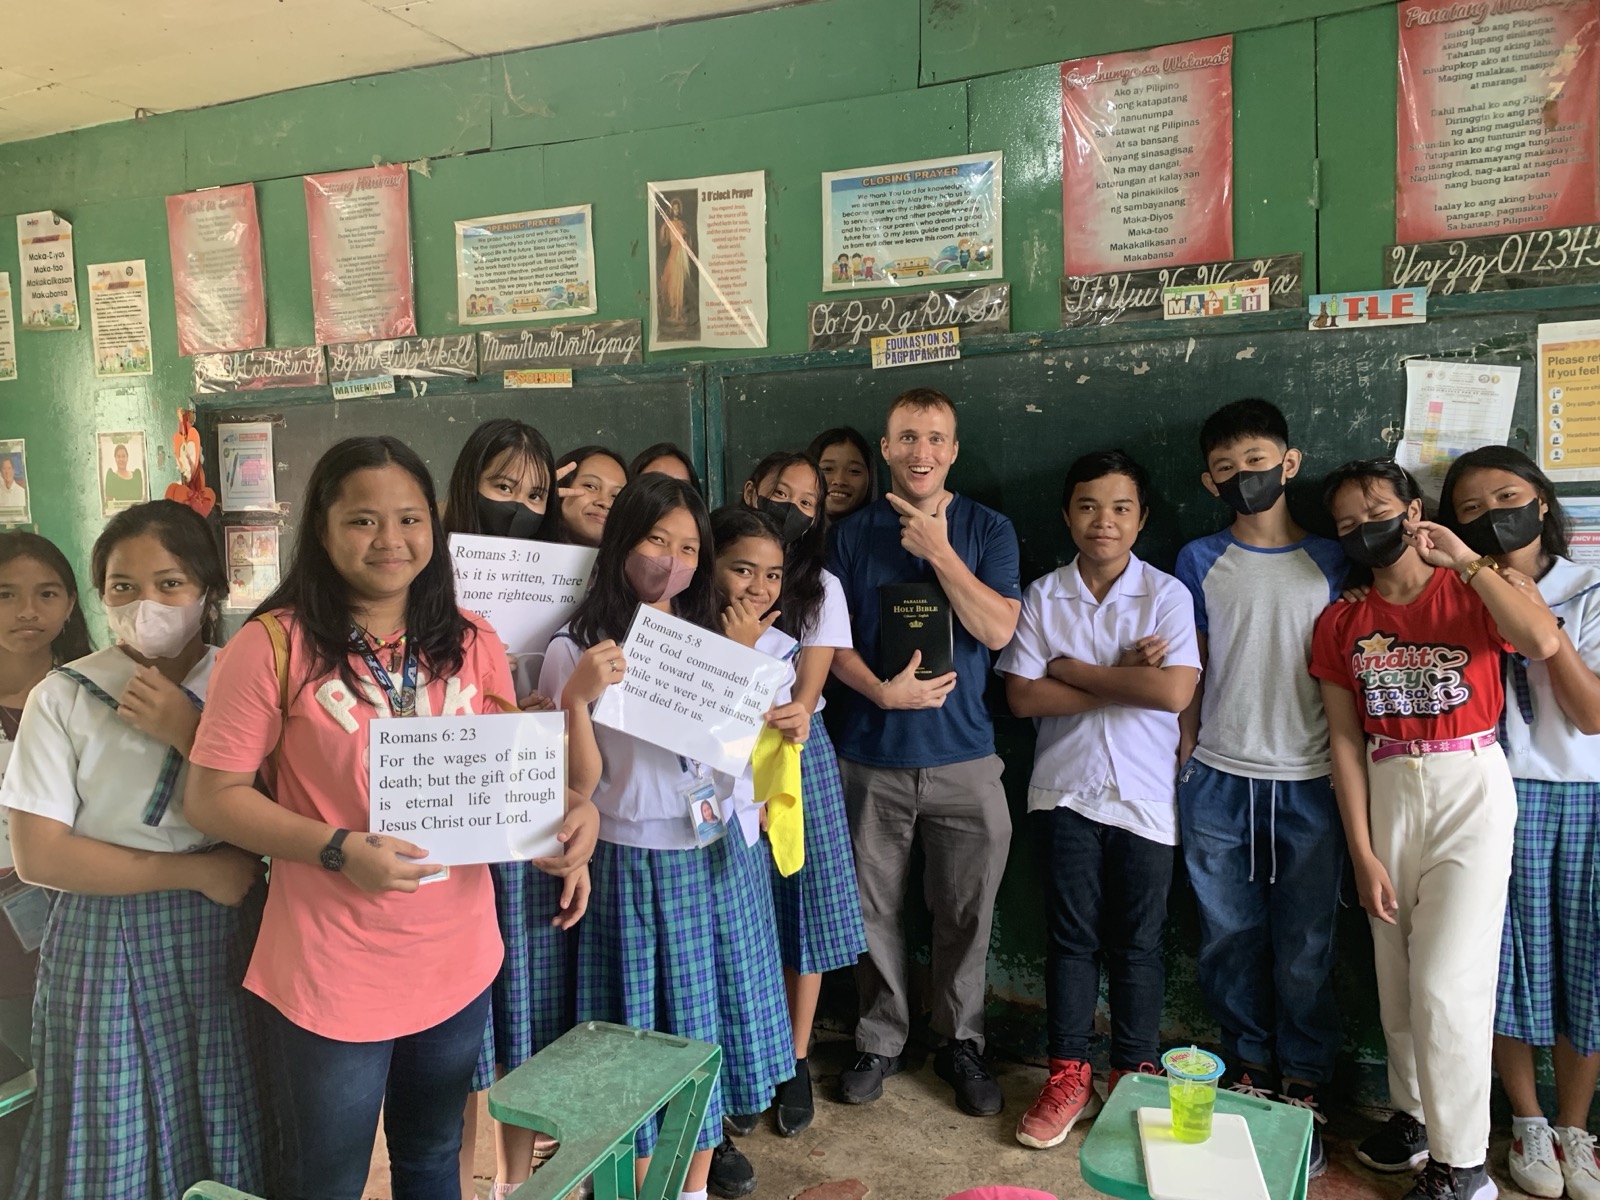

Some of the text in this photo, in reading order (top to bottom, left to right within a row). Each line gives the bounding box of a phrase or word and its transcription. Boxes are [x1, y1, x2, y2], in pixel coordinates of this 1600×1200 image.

[1406, 2, 1490, 28] Panatang
[1140, 65, 1159, 75] sa
[1163, 46, 1230, 73] Watawat
[1438, 70, 1474, 83] Maging
[1470, 76, 1527, 90] at marangal
[1114, 88, 1131, 97] Ako
[1146, 83, 1179, 94] Pilipino
[1107, 94, 1188, 111] uong katapatang
[1120, 109, 1173, 122] nanunumpa
[1095, 130, 1106, 138] Sa
[1162, 119, 1200, 131] Pilipinas
[1141, 135, 1178, 145] bansang
[1141, 146, 1193, 159] sinasagisag
[862, 167, 959, 187] CLOSING PRAYER
[1113, 167, 1125, 175] Na
[1128, 165, 1147, 173] may
[1096, 178, 1146, 190] katarungan
[1159, 171, 1200, 183] kalayaan
[1445, 171, 1550, 189] nang buong katapatan
[702, 188, 754, 202] 3 O'clock Prayer
[1132, 187, 1179, 199] pinakikilos
[1479, 198, 1495, 207] ang
[1499, 195, 1525, 205] aking
[1528, 191, 1558, 202] buhay
[1111, 199, 1186, 214] ng sambayanang
[486, 217, 560, 232] OPENING PRAYER
[1123, 213, 1173, 225] Maka-Diyos
[1461, 219, 1500, 230] bansang
[1503, 215, 1543, 225] Pilipinas
[1128, 226, 1169, 237] Maka-tao
[1110, 237, 1187, 251] Makakalikasan at
[1123, 251, 1174, 262] Makabansa
[34, 265, 63, 273] Maka-tao
[26, 277, 72, 287] Makakalikasan
[32, 290, 68, 299] Makabansa
[1168, 294, 1261, 315] MAPEH
[1343, 293, 1414, 322] TLE
[886, 332, 954, 351] EDUKASYON SA
[885, 345, 957, 365] PAGPAPAKATAO
[1548, 356, 1584, 366] Please
[517, 373, 570, 383] SCIENCE
[1548, 365, 1599, 379] if you feel
[335, 381, 393, 395] MATHEMATICS
[456, 546, 540, 563] Romans 3: 10
[454, 568, 582, 585] As it is written, There
[463, 590, 492, 599] none
[498, 589, 554, 603] righteous,
[642, 616, 702, 648] Romans 5:8
[635, 632, 769, 695] But God commandeth his
[629, 649, 651, 664] love
[659, 661, 694, 681] toward
[702, 679, 714, 692] us,
[724, 686, 734, 698] in
[621, 680, 704, 722] hrist died for us.
[655, 678, 669, 689] we
[674, 687, 697, 700] were
[700, 697, 716, 709] yet
[719, 704, 756, 727] sinners,
[1404, 690, 1427, 700] sa
[1368, 701, 1440, 715] isa't isa
[379, 728, 477, 744] Romans 6: 23
[380, 747, 556, 767] For the wages of sin is
[379, 767, 556, 789] death; but the gift of God
[380, 788, 556, 810] is eternal life through
[379, 811, 532, 832] Jesus Christ our Lord.
